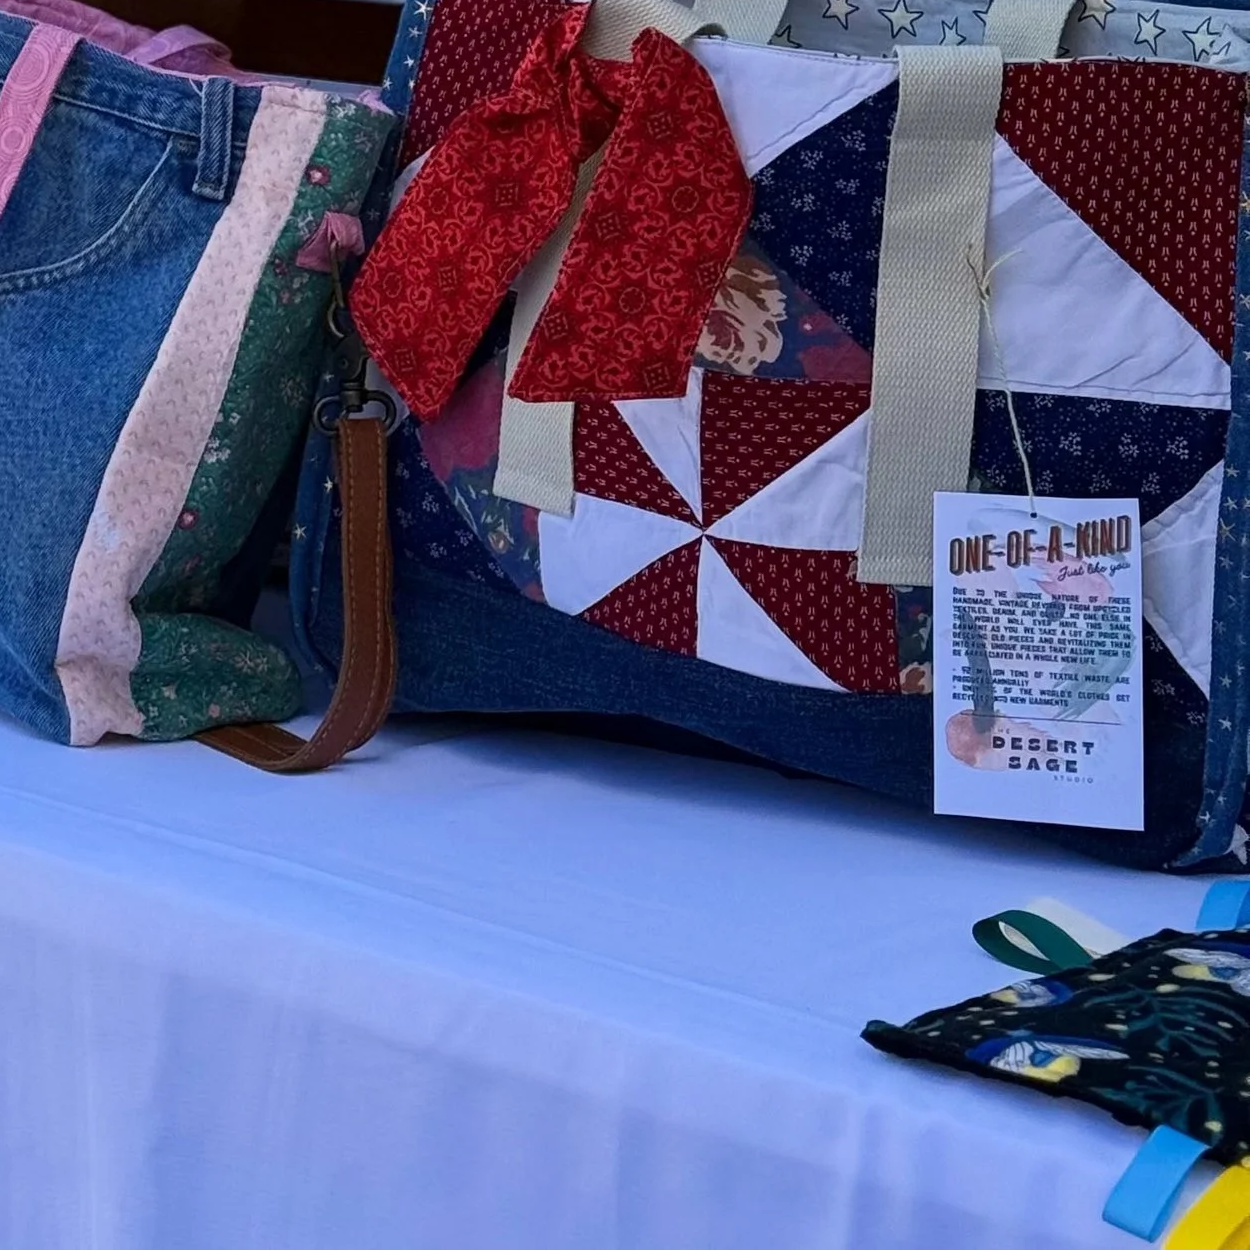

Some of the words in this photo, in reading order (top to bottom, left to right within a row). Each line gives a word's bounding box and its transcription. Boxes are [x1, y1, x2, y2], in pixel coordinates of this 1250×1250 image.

[950, 515, 1131, 576] ONE-OF-A-KIND
[1057, 566, 1084, 582] Just
[1086, 562, 1108, 574] like
[1108, 562, 1131, 577] you
[994, 590, 1007, 598] THE
[1051, 594, 1080, 602] NATURE
[1069, 603, 1090, 611] FROM
[1101, 614, 1119, 622] ELSE
[1038, 628, 1057, 636] TAKE
[1086, 622, 1102, 630] THIS
[1110, 623, 1131, 631] SAME
[1009, 635, 1034, 643] PIECES
[1058, 637, 1106, 647] REVITALIZING
[1033, 654, 1058, 662] WHOLE
[1049, 646, 1066, 654] THAT
[1070, 647, 1096, 655] ALLOW
[1098, 649, 1118, 657] THEM
[1122, 650, 1130, 658] TO
[1011, 670, 1028, 678] TONS
[1049, 673, 1079, 681] TEXTILE
[1085, 675, 1110, 683] WASTE
[1115, 676, 1130, 684] ARE
[1078, 691, 1110, 701] CLOTHES
[1116, 694, 1130, 702] GET
[992, 736, 1094, 755] DESERT
[1008, 756, 1078, 773] SAGE
[1054, 775, 1094, 783] STUDIO
